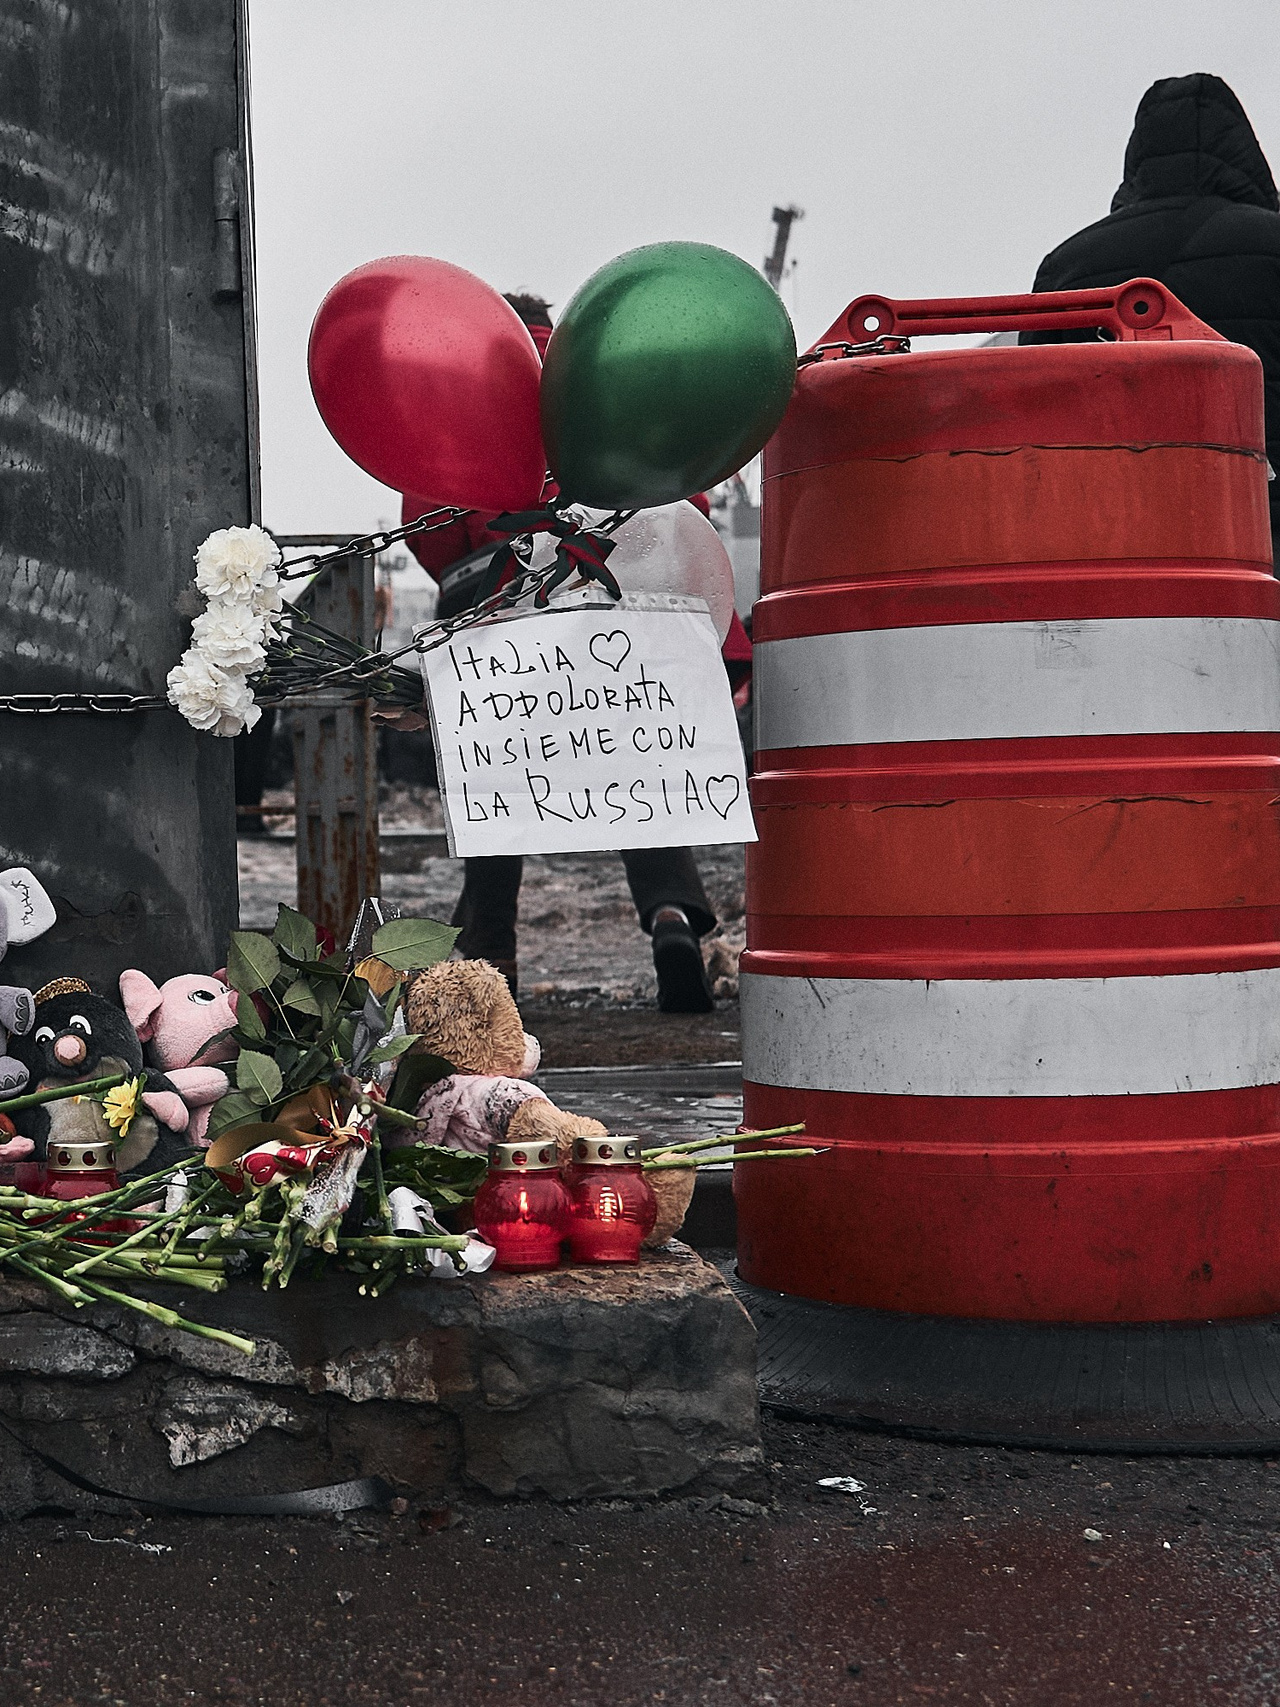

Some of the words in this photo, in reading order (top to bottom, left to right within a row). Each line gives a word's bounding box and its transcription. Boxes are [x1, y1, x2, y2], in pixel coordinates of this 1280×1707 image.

[458, 663, 676, 727] ADDOLORATA
[632, 724, 697, 754] CON
[462, 781, 510, 822] LA
